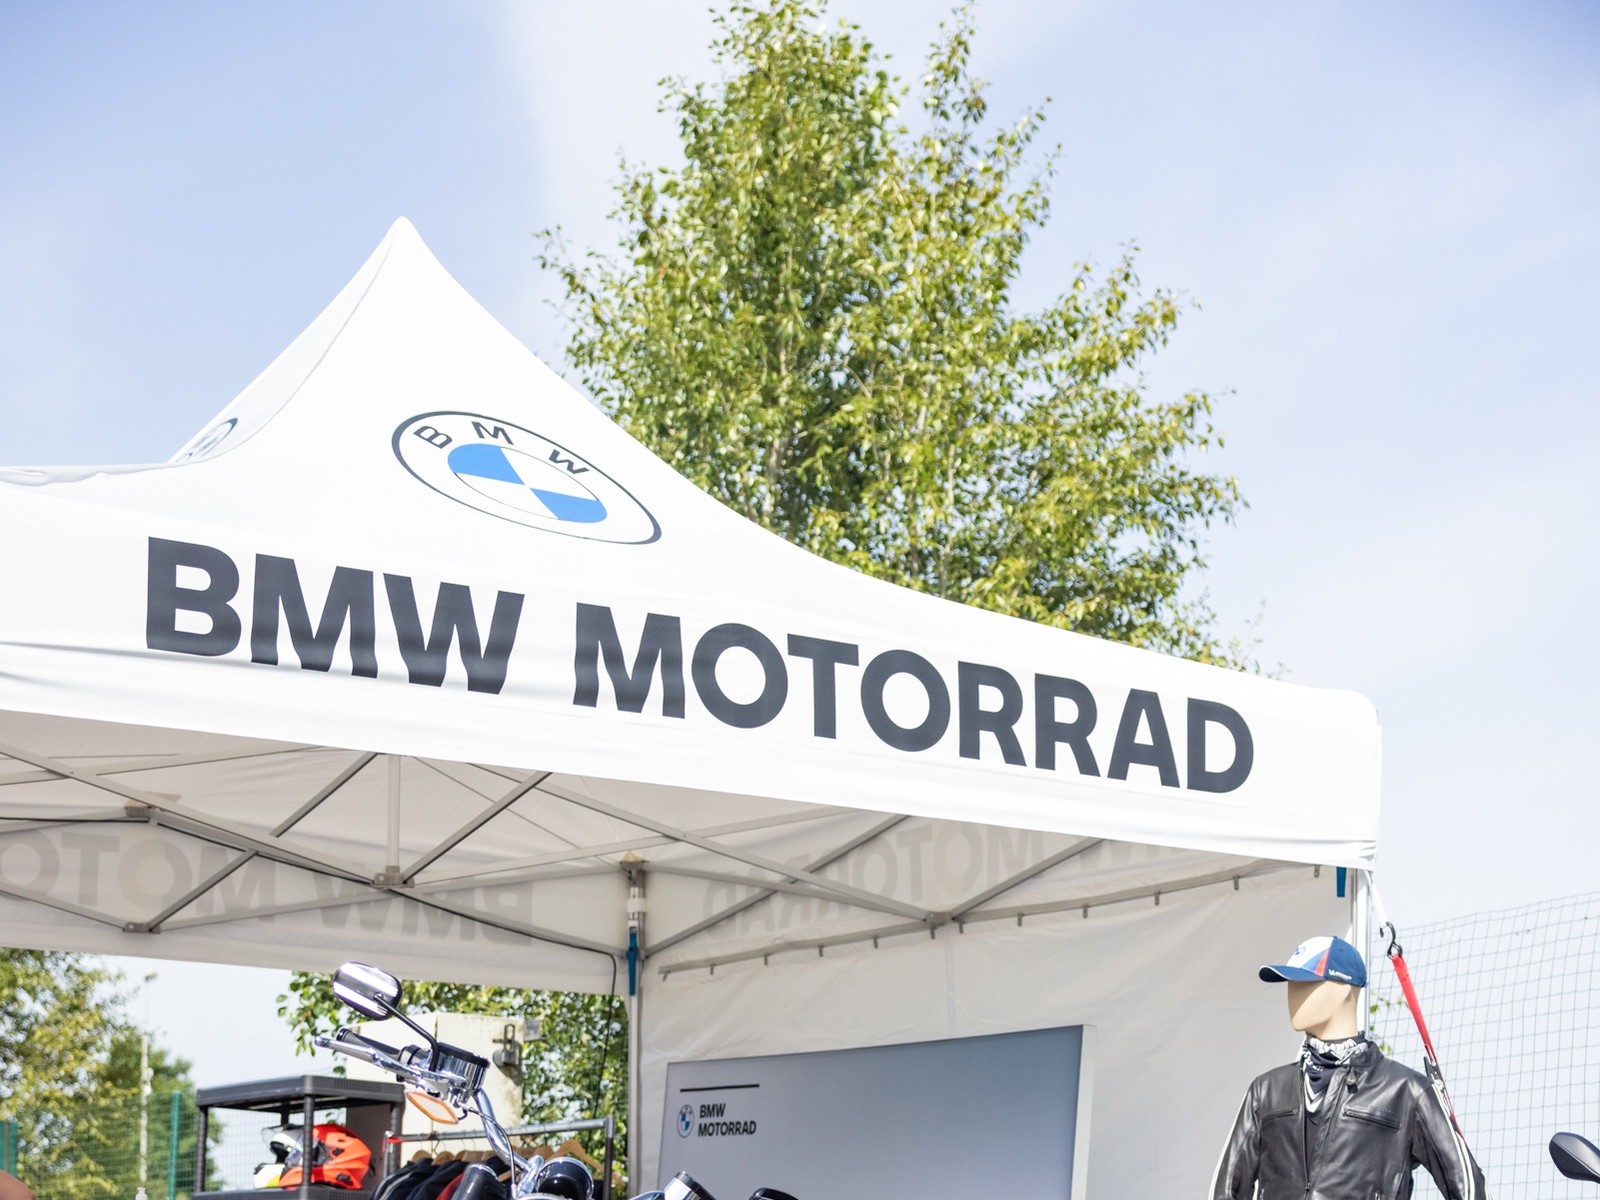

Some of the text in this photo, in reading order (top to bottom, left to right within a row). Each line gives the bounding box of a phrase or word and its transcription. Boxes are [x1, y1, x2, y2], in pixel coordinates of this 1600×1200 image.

[413, 421, 589, 475] BMW
[147, 536, 1254, 794] BMW MOTORRAD
[698, 1120, 757, 1137] MOTORRAD
[699, 1103, 726, 1119] BMW
